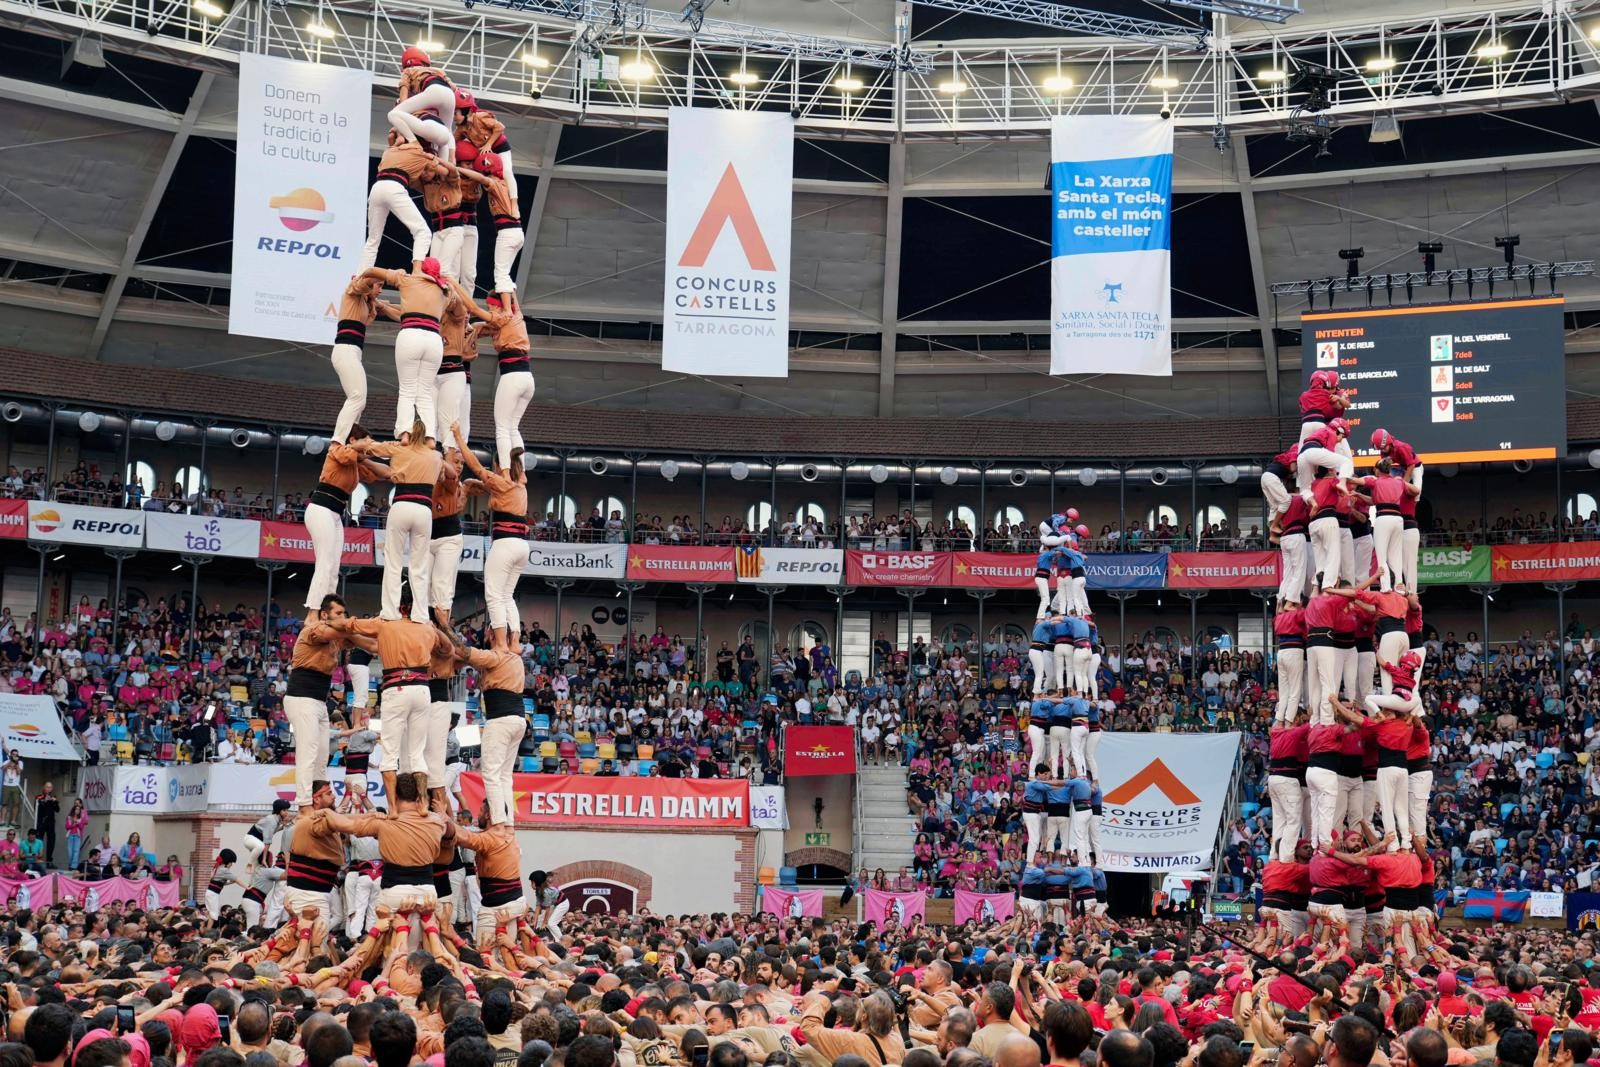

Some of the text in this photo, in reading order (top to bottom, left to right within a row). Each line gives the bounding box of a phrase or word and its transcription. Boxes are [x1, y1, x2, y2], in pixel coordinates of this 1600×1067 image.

[265, 84, 321, 105] Donem
[264, 105, 348, 128] suport a la
[263, 121, 331, 144] tradició i
[262, 141, 337, 165] la cultura
[1074, 175, 1151, 187] La Xarxa
[1058, 190, 1166, 205] Santa Tecla,
[1057, 207, 1162, 220] amb el món
[1073, 224, 1152, 236] casteller
[257, 236, 342, 260] REPSOL
[675, 276, 777, 294] CONCURS
[675, 294, 776, 312] CASTELLS
[1061, 311, 1160, 321] XARXA SANTA TECLA
[674, 320, 776, 337] TARRAGONA
[1099, 320, 1126, 329] Social
[1135, 331, 1155, 340] 1171
[1315, 328, 1364, 338] INTENTEN
[1476, 333, 1511, 341] VENDRELL
[1358, 371, 1398, 379] BARCELONA
[1473, 395, 1515, 403] TARRAGONA
[72, 519, 142, 535] REPSOL
[184, 531, 222, 551] tac
[279, 538, 313, 550] ESTRE
[529, 550, 614, 569] CaixaBank
[888, 555, 935, 569] BASF
[1423, 550, 1472, 566] BASF
[1511, 556, 1600, 570] ESTRELLA DAMM
[645, 559, 733, 571] ESTRELLA DAMM
[776, 561, 840, 573] REPSOL
[1083, 565, 1162, 577] VANGUARDIA
[1186, 565, 1275, 577] ESTRELLA DAMM
[862, 572, 874, 580] We
[900, 573, 935, 582] chemistry
[971, 566, 1022, 577] ESTRELLA
[1436, 570, 1473, 580] chemistry
[8, 735, 56, 745] REPSOL
[123, 786, 158, 805] tac
[531, 791, 742, 819] ESTRELLA DAMM
[751, 807, 778, 819] tac
[1102, 827, 1199, 839] ARRAGONA
[1215, 903, 1240, 912] SORTIDA
